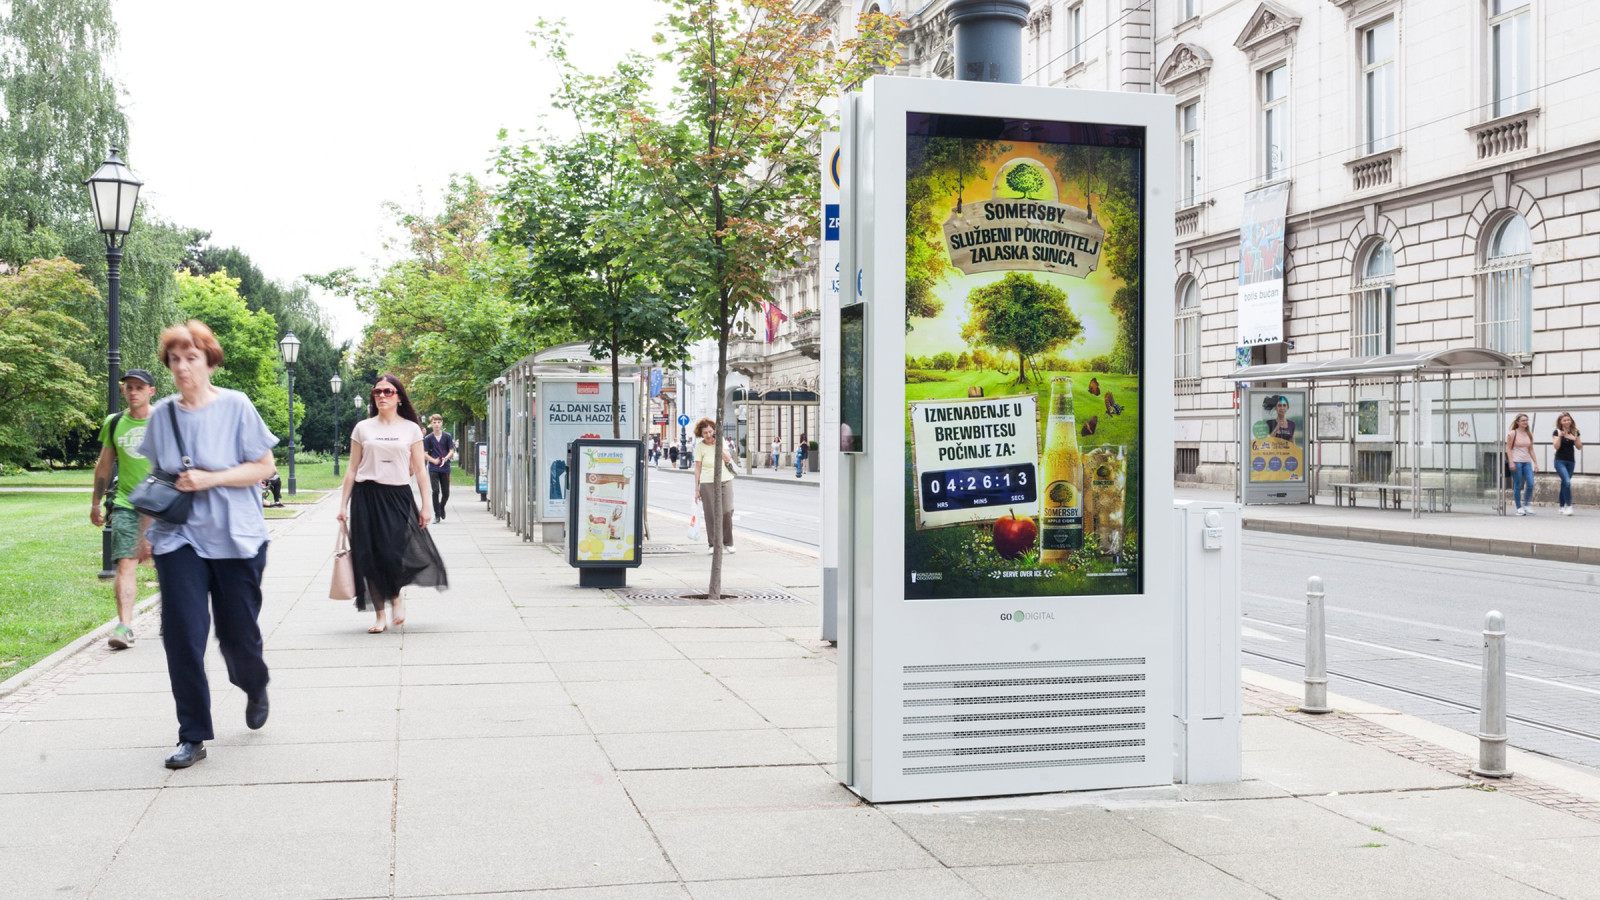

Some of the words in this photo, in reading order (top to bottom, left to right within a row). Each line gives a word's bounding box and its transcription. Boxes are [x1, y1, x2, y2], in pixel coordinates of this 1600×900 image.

[950, 226, 1012, 250] SLUŽBENI
[1015, 227, 1099, 255] POKROVITELJ
[970, 245, 1029, 264] ZALASKA
[1032, 245, 1078, 268] SUNCA.
[549, 403, 565, 413] 41.
[567, 403, 592, 413] DANI
[593, 403, 627, 413] SATE
[924, 403, 1011, 423] IZNENAĐENJE
[1013, 402, 1022, 417] U
[549, 413, 583, 423] FADILA
[935, 422, 1016, 442] BREWBITESU
[938, 442, 992, 461] POČINJE
[995, 442, 1016, 458] ZA:
[1011, 494, 1025, 502] SECS
[1044, 508, 1079, 517] SOMERSBY
[1002, 570, 1019, 578] SERVE
[1000, 612, 1013, 621] GO
[1024, 611, 1056, 621] DIGITAL
